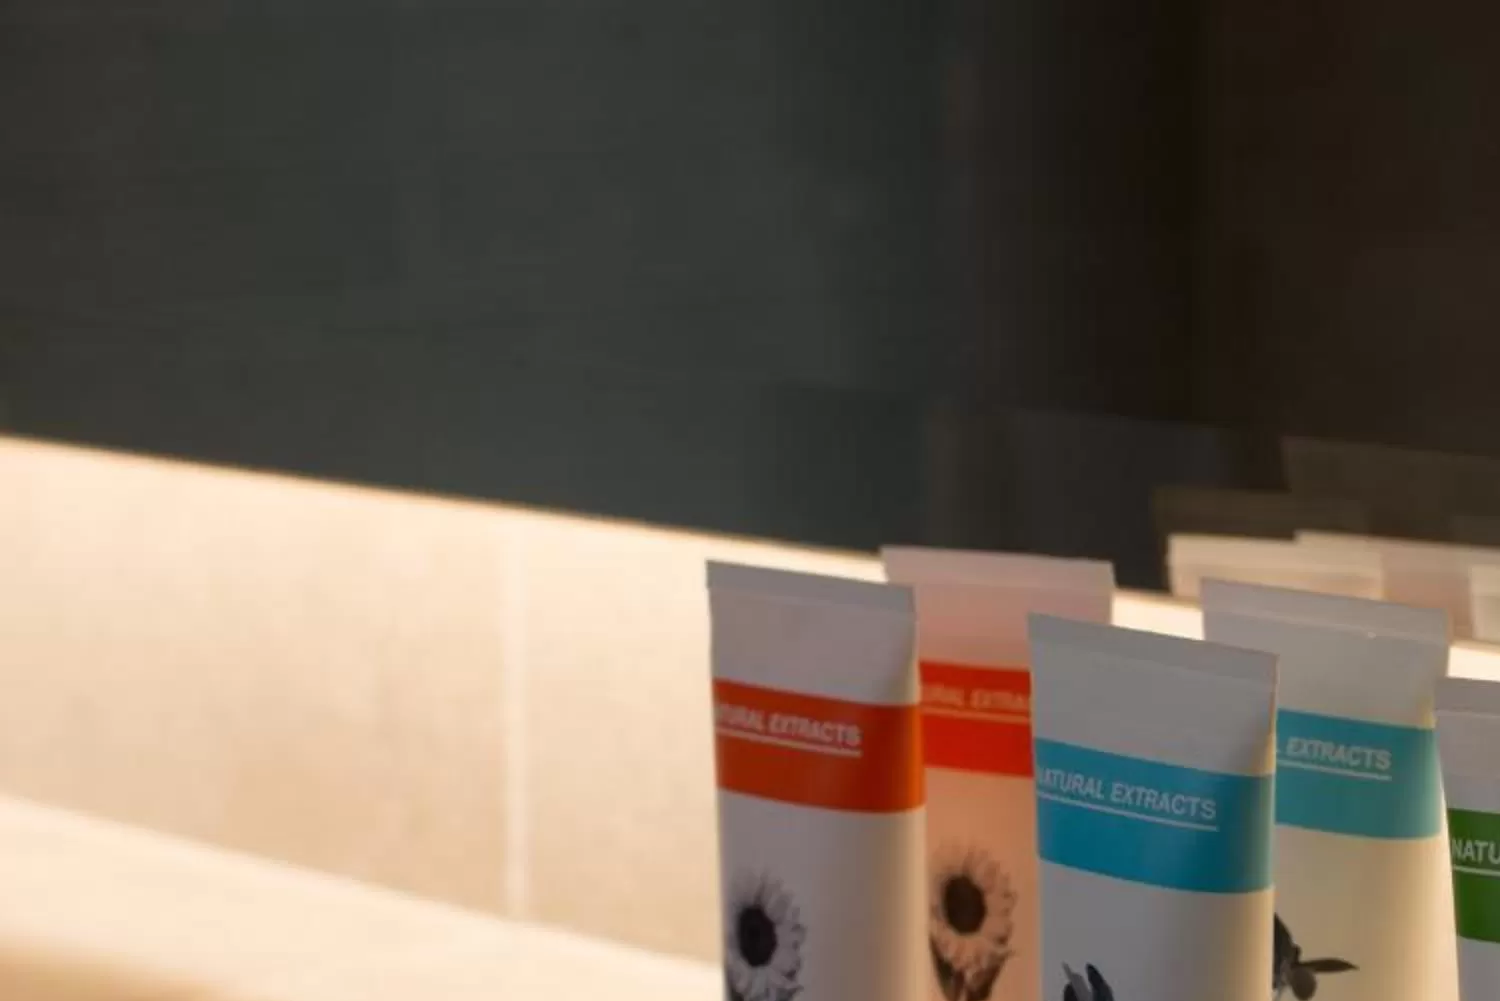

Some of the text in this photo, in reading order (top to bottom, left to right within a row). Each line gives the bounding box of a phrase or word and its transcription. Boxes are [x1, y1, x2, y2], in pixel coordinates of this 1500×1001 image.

[768, 711, 864, 747] EXTRACTS
[1286, 737, 1392, 770] EXTRACTS
[1110, 781, 1217, 820] EXTRACTS
